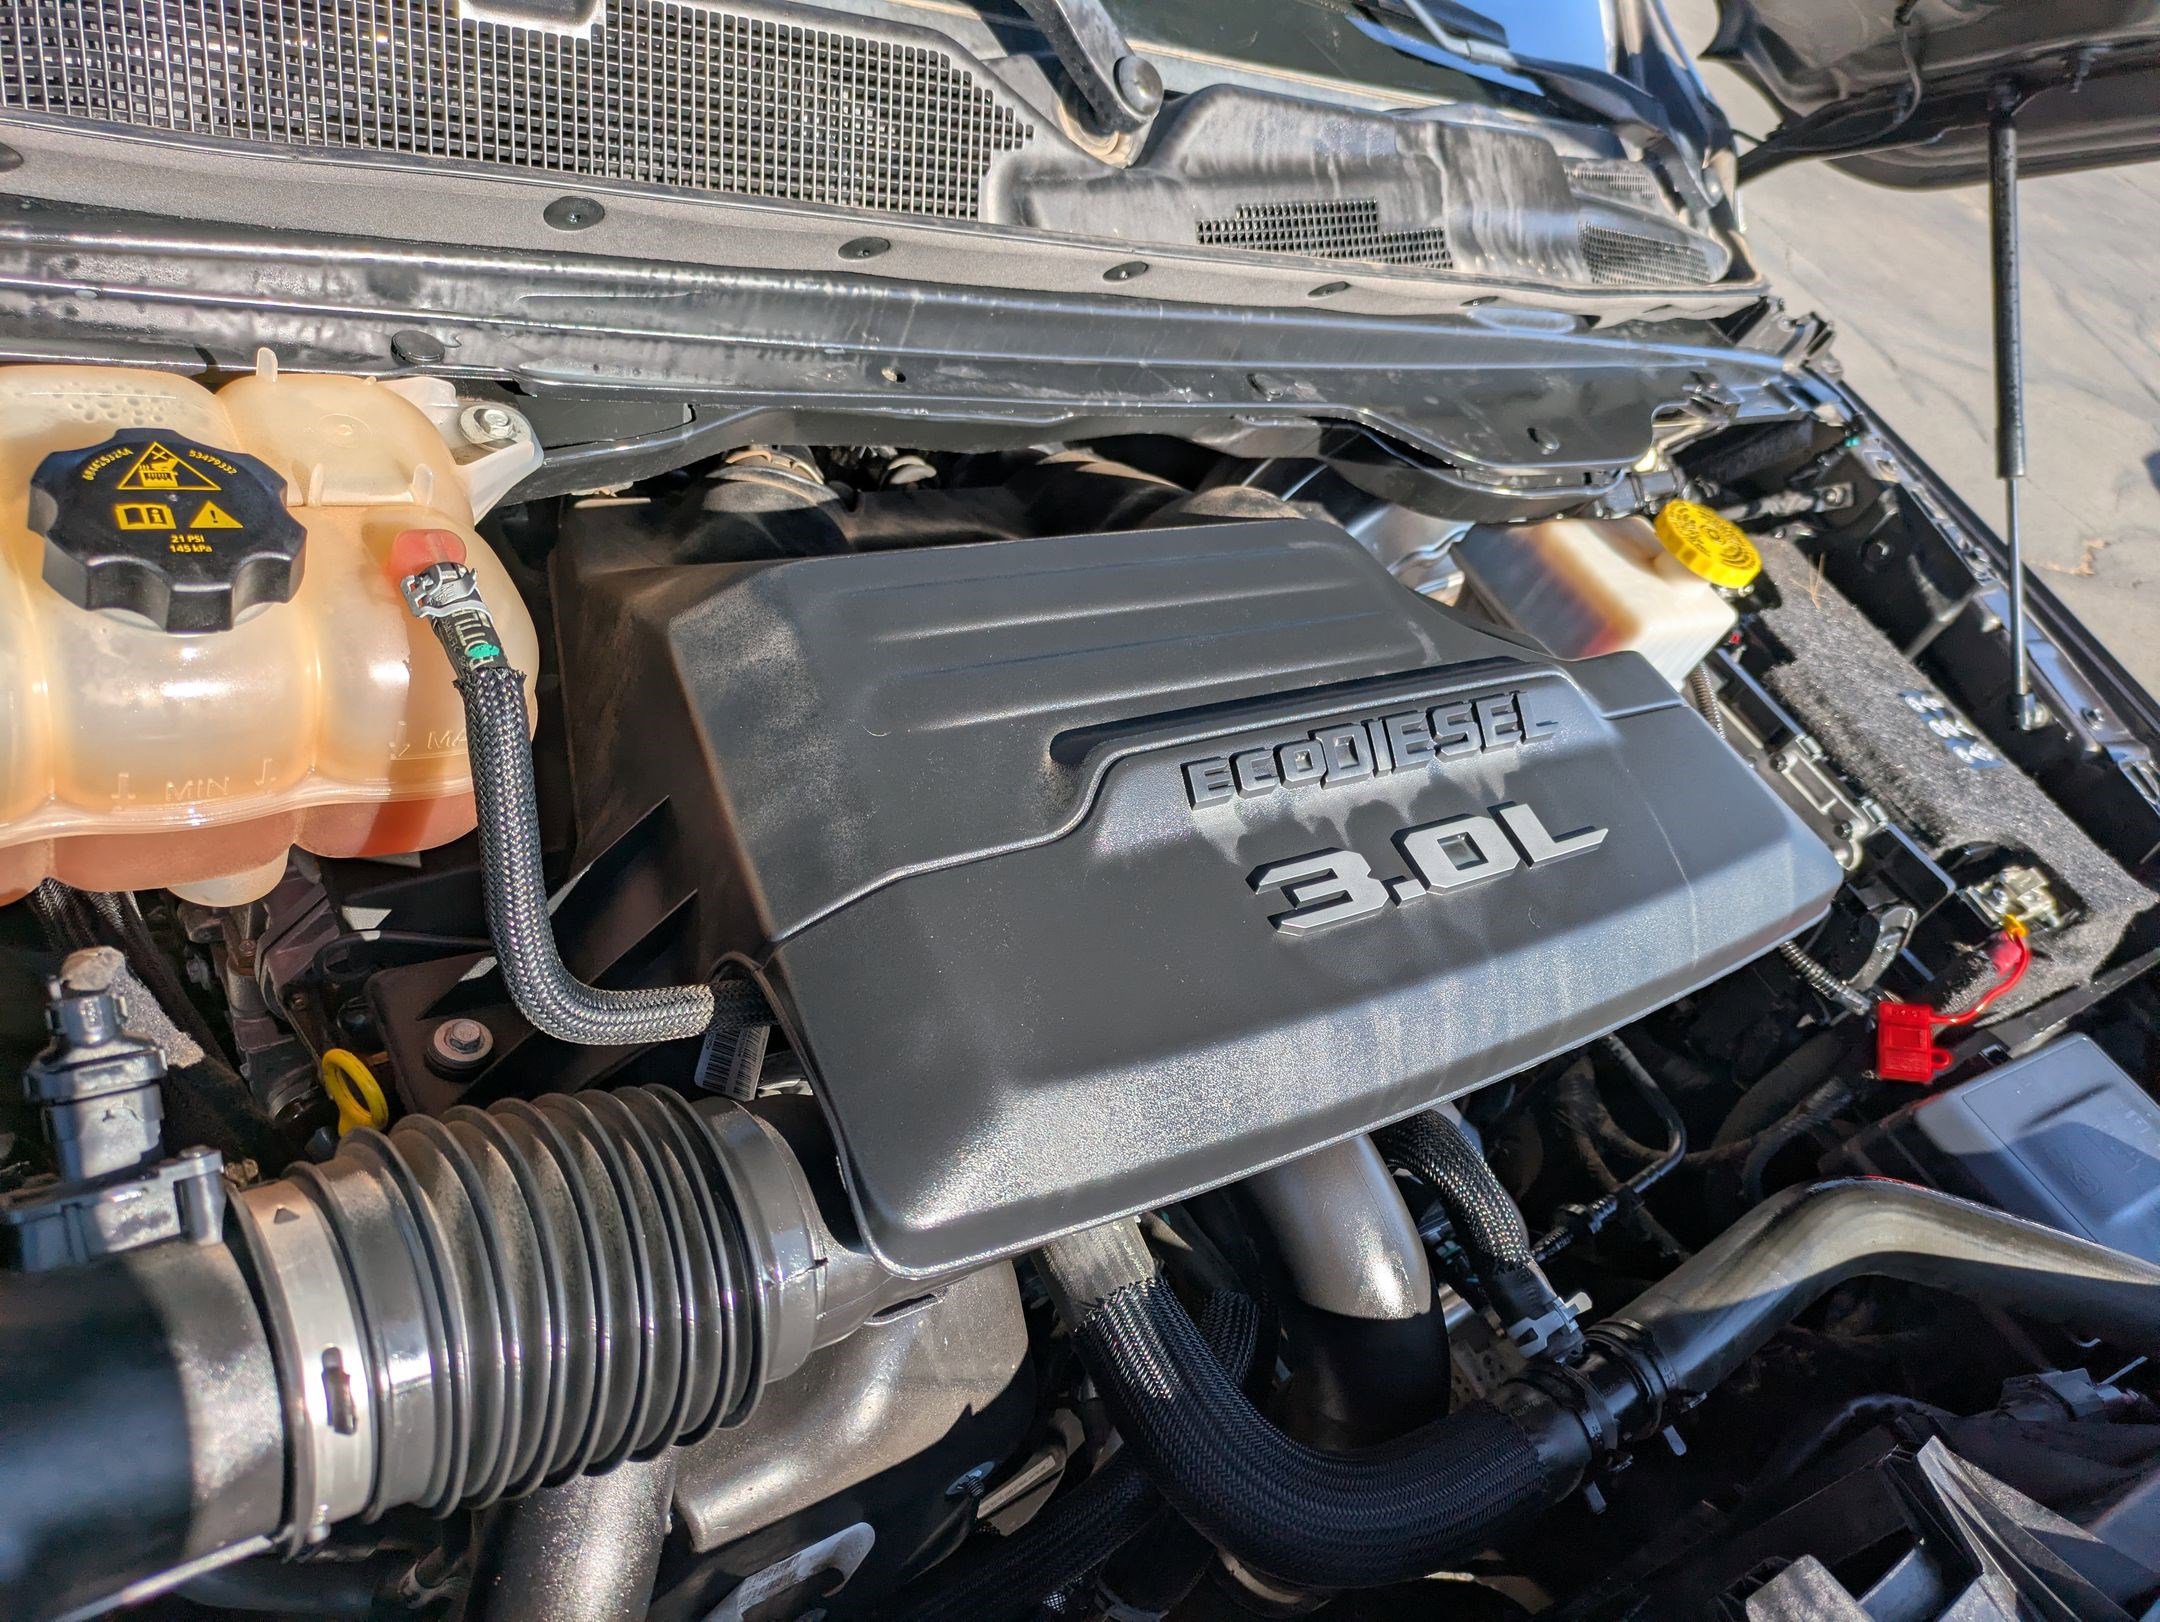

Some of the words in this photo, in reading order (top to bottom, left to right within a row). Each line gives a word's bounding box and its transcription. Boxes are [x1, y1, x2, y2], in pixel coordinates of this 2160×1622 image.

[169, 543, 191, 553] 145
[191, 543, 213, 553] kPa
[170, 534, 185, 543] 21
[187, 534, 205, 543] PSI
[427, 729, 467, 750] MA
[1181, 690, 1558, 810] ECODIESEL
[165, 776, 230, 802] MIN
[1245, 801, 1608, 936] 3.0L
